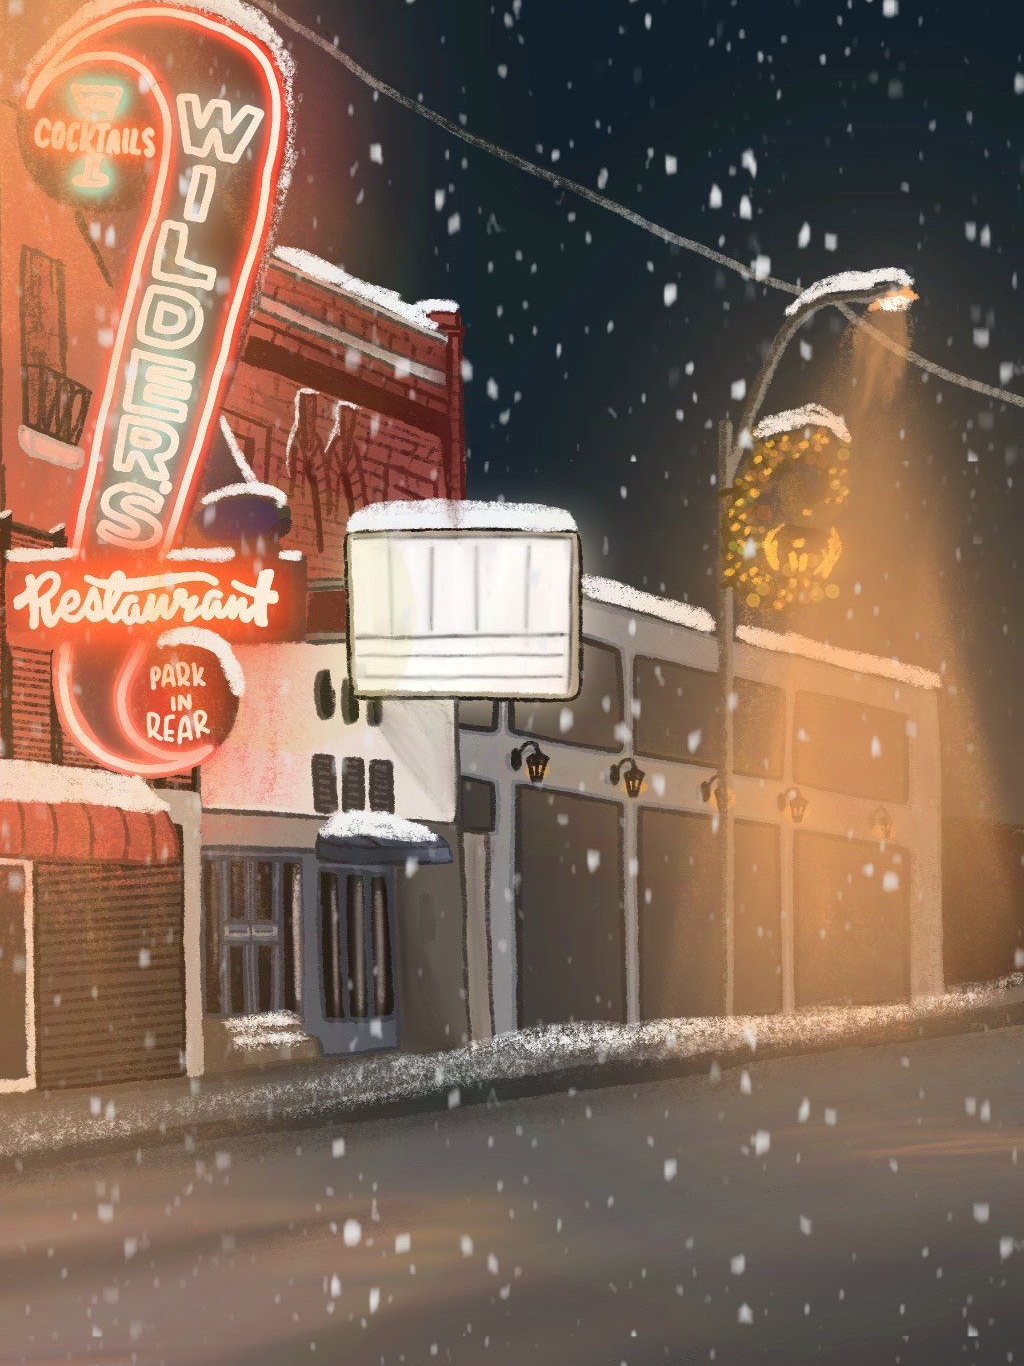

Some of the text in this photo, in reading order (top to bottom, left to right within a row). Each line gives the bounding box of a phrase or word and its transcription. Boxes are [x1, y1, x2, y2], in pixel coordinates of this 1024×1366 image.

[33, 117, 156, 158] COCKTAILS
[13, 569, 279, 630] Restaurant
[150, 661, 207, 691] PARK
[170, 693, 193, 712] IN
[146, 709, 211, 745] REAR
